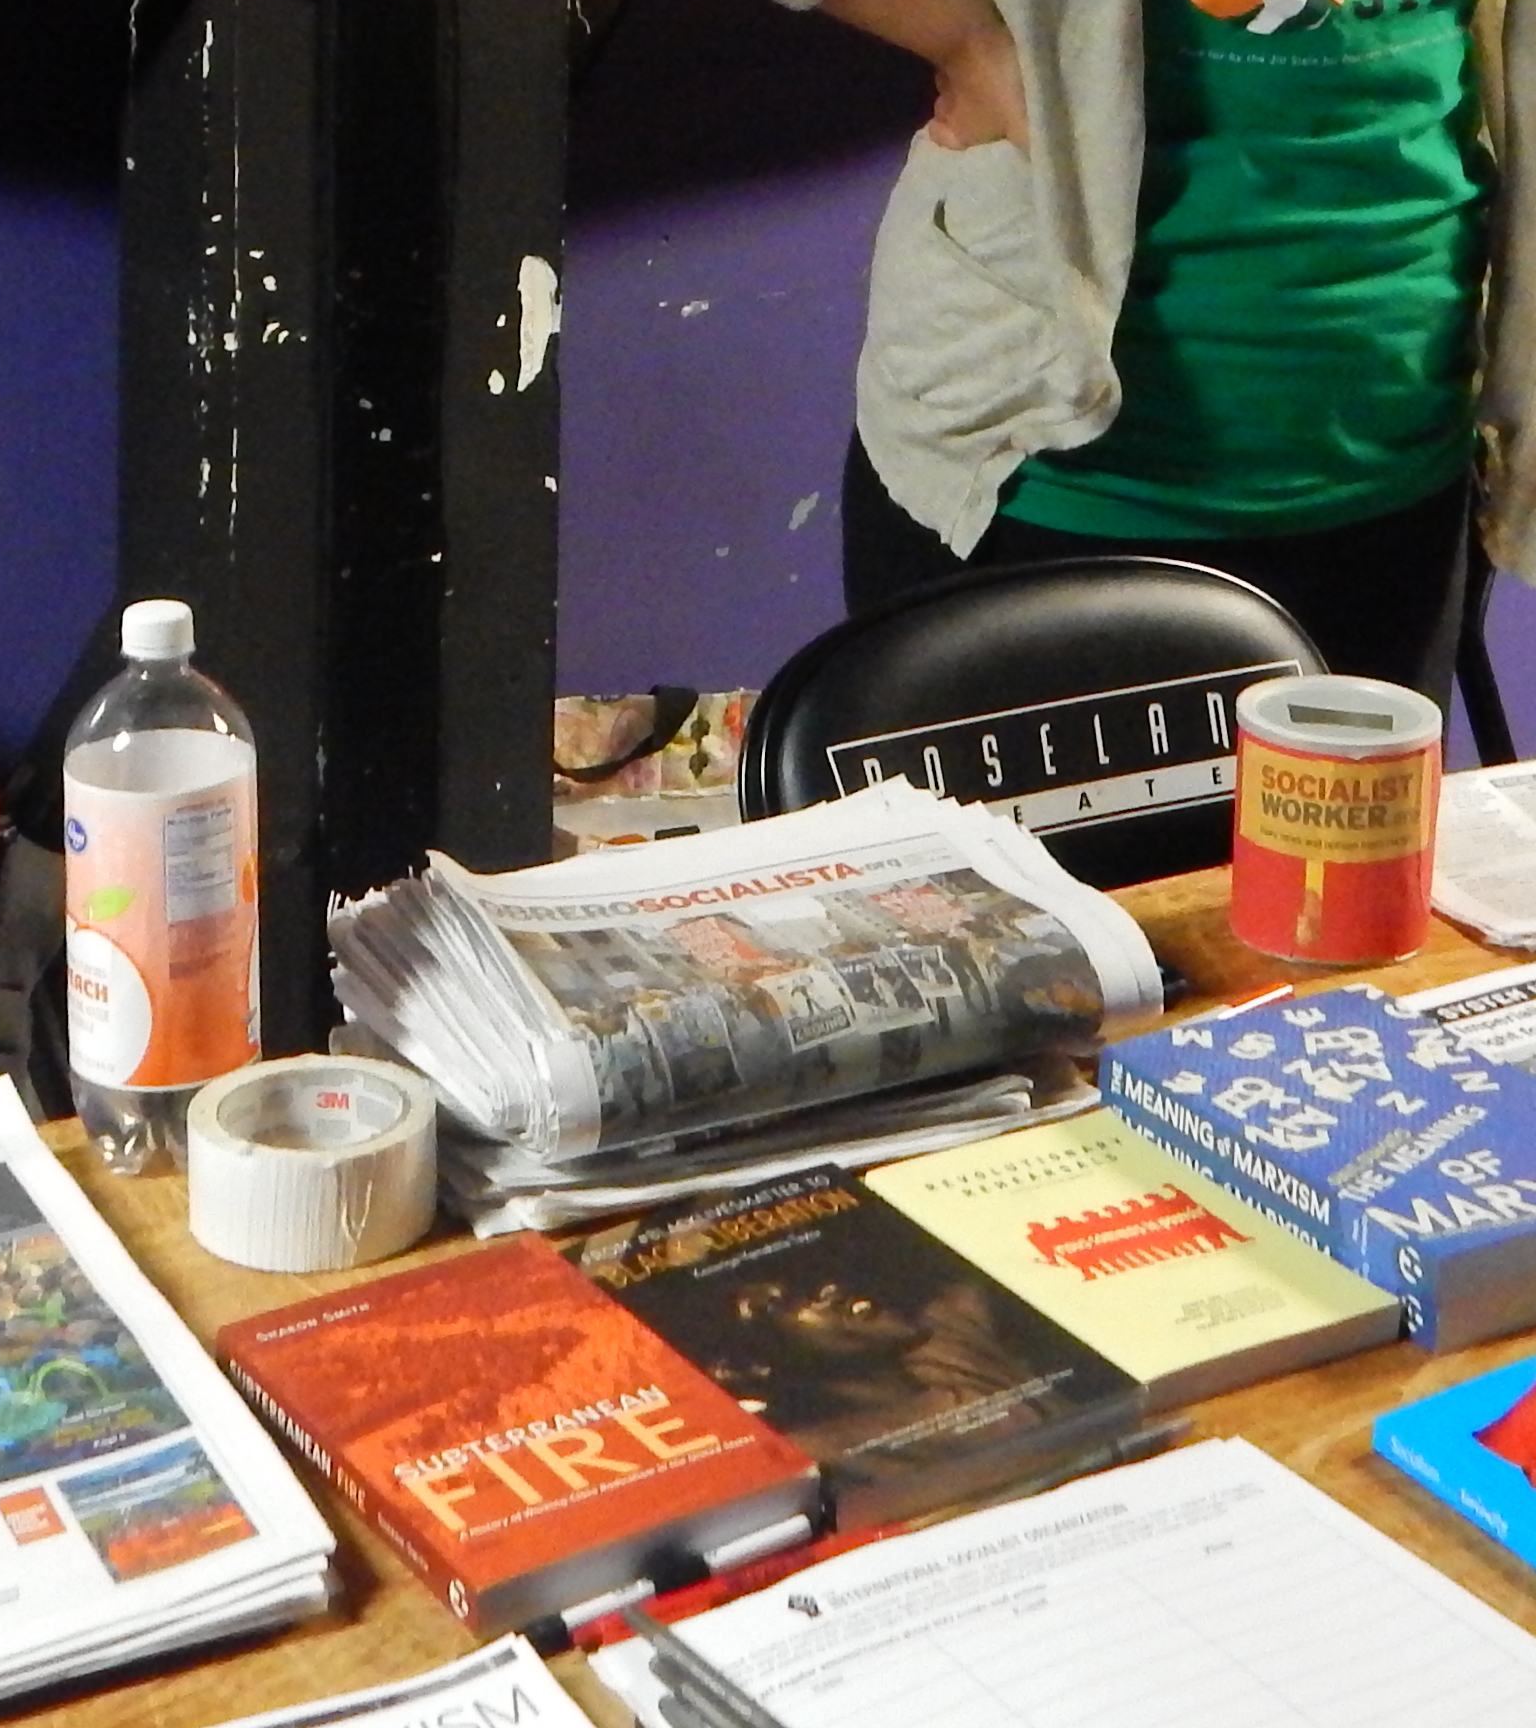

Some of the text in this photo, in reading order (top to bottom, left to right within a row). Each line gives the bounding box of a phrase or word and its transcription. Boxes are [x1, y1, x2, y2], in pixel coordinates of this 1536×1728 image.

[863, 691, 1232, 800] ROSELAN
[1261, 764, 1414, 804] SOCIALIST
[315, 1092, 350, 1112] 3M
[1124, 1072, 1215, 1152] MEANING
[1216, 1135, 1232, 1158] of
[1232, 1141, 1331, 1226] MARXISM
[1338, 1168, 1396, 1203] THE
[1388, 1100, 1488, 1175] MEANING
[1438, 1148, 1503, 1186] OF
[229, 1358, 367, 1513] SUBTERRANEAN FIRE
[393, 1383, 668, 1483] SUBTERRANEAN
[400, 1399, 720, 1533] FIRE
